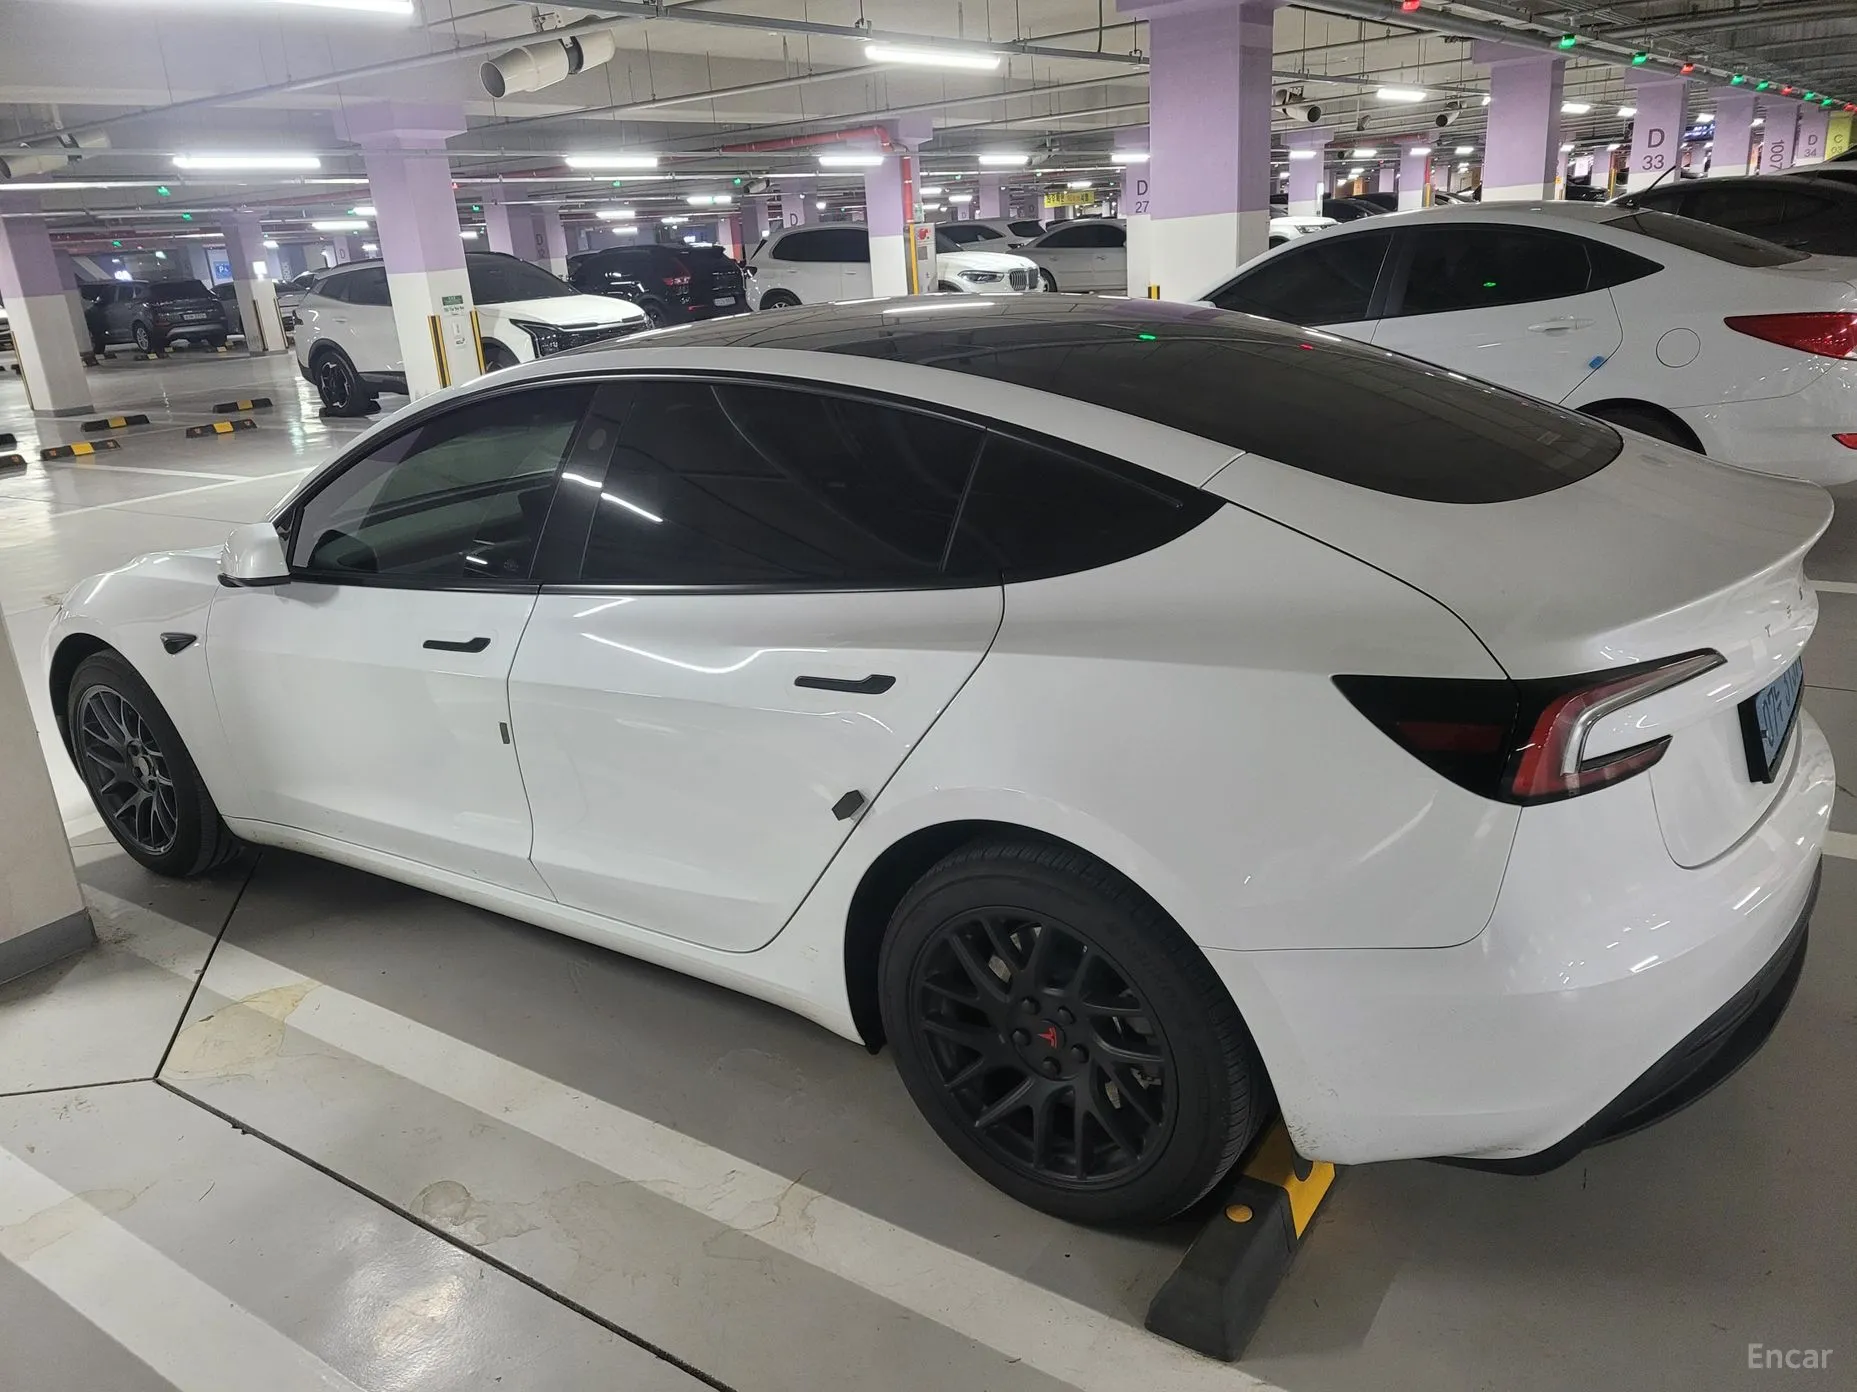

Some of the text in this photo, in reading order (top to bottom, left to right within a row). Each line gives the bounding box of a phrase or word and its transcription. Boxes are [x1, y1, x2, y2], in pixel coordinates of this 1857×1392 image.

[1648, 128, 1665, 148] D
[1808, 134, 1819, 146] D
[1834, 133, 1843, 144] C
[1769, 139, 1785, 169] 1007
[1804, 148, 1817, 158] 34
[1642, 154, 1665, 171] 33
[1136, 180, 1149, 196] D
[1135, 200, 1150, 214] 27
[790, 213, 799, 226] D
[536, 233, 544, 246] D
